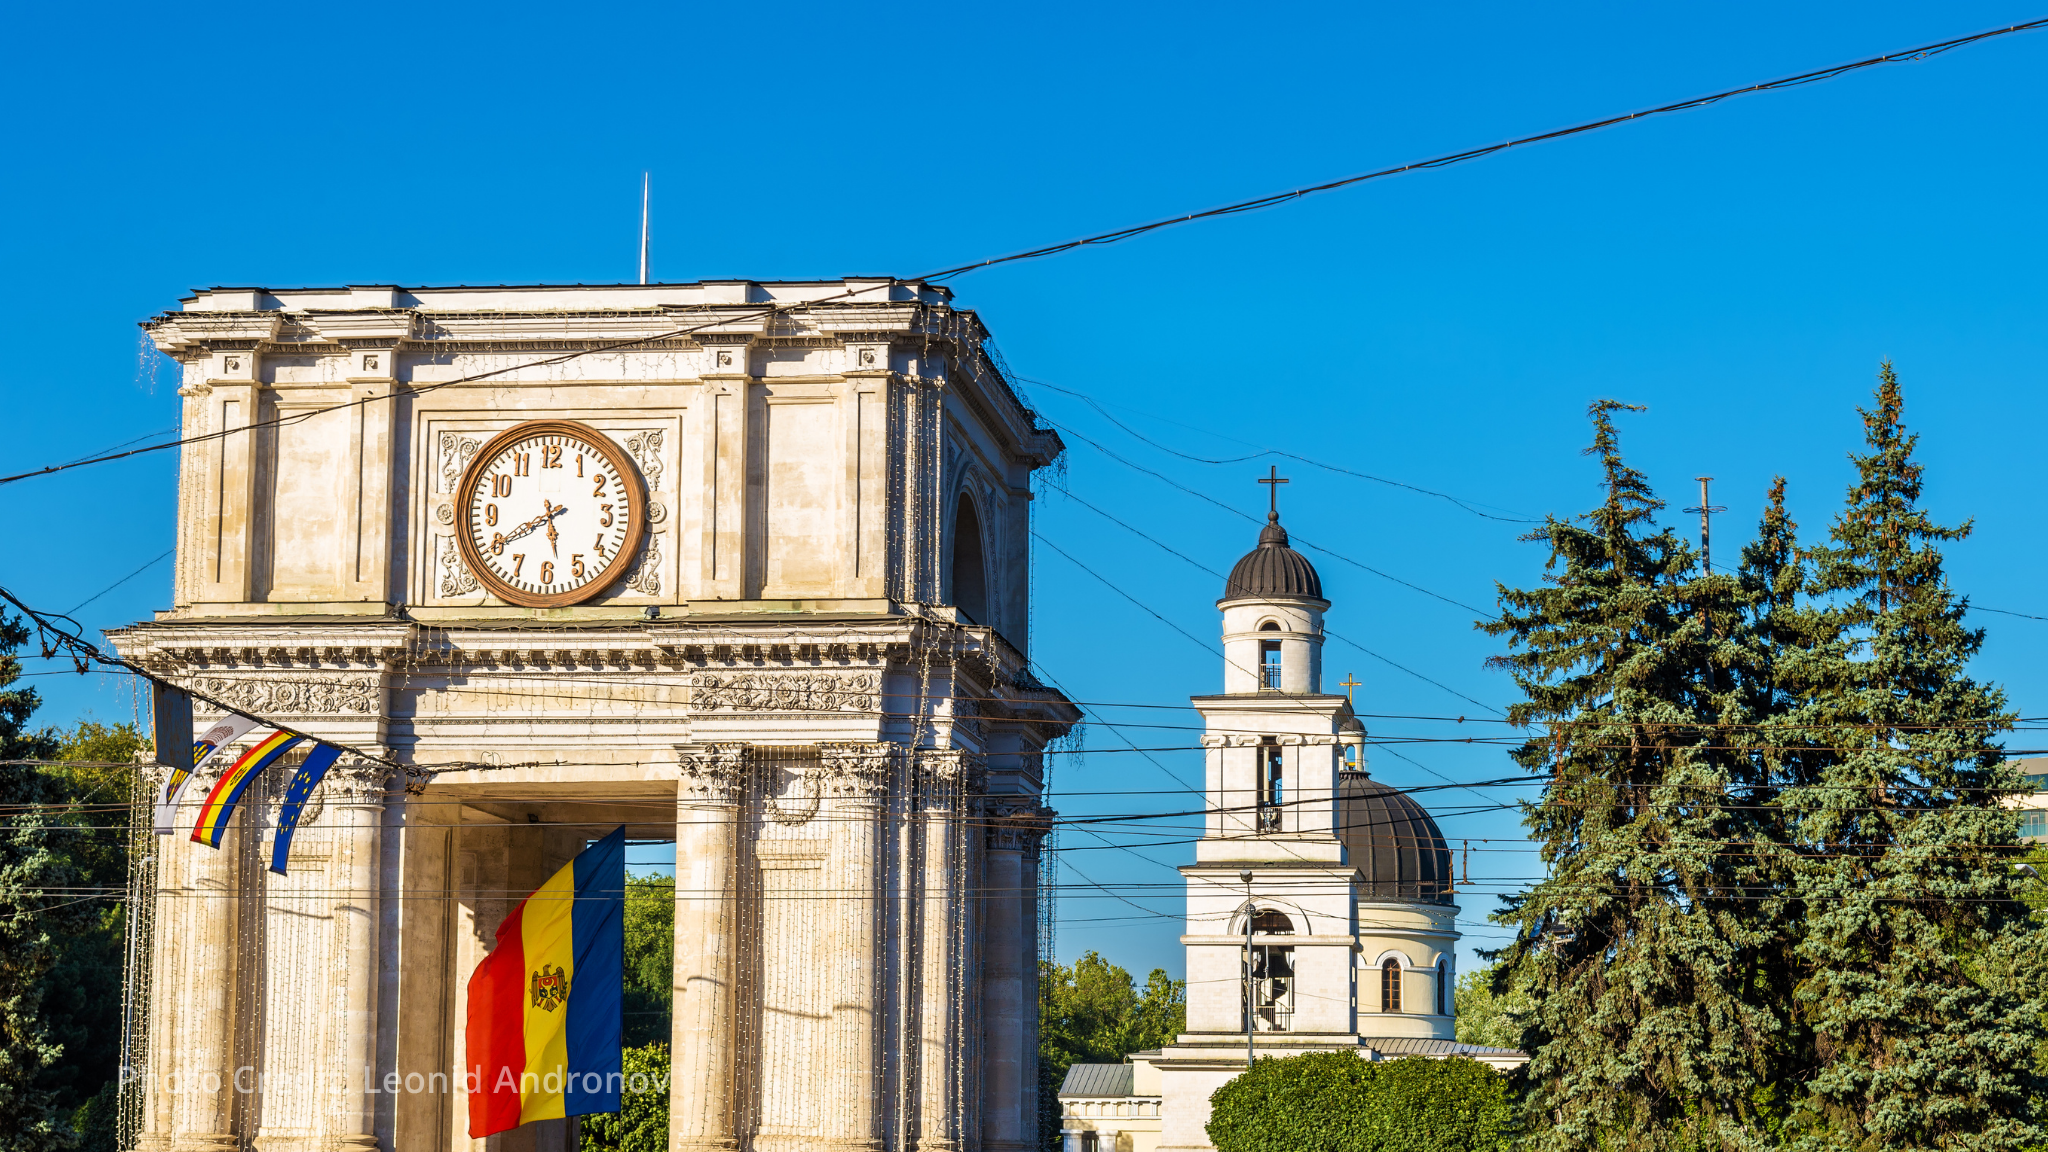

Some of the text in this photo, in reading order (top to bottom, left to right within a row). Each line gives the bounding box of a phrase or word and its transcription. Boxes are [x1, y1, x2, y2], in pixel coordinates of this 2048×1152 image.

[513, 452, 529, 476] 11
[542, 445, 562, 468] 12
[576, 454, 583, 477] 1
[491, 474, 512, 498] 10
[593, 474, 606, 497] 2
[485, 503, 498, 526] 9
[600, 504, 613, 527] 3
[490, 532, 504, 556] 8
[593, 533, 605, 557] 4
[513, 554, 525, 577] 7
[540, 561, 554, 584] 6
[571, 554, 584, 578] 5
